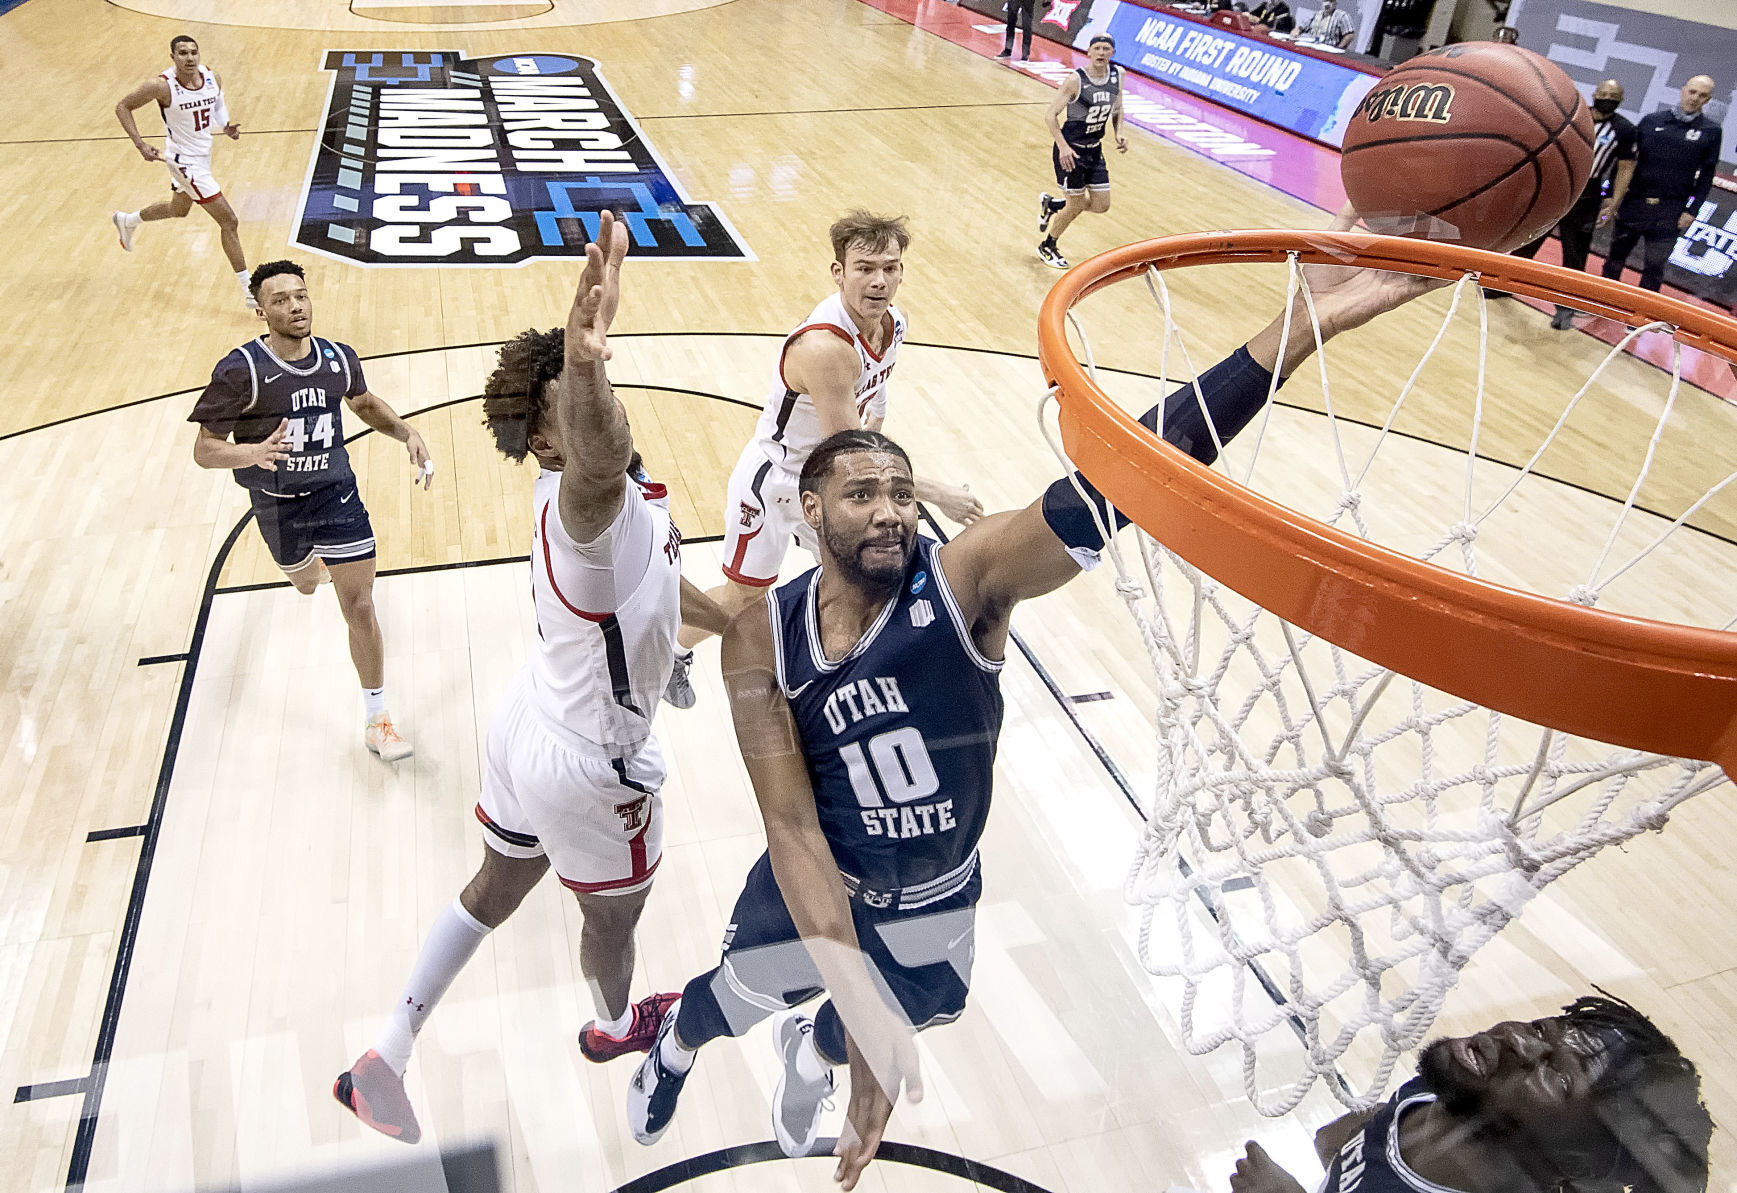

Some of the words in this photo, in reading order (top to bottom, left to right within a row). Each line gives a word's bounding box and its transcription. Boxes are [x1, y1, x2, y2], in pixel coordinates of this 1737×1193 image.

[1135, 17, 1184, 53] NCAA
[1177, 31, 1235, 68] FIRST
[1225, 46, 1302, 91] ROUND
[1141, 53, 1172, 72] HOSTED
[1168, 62, 1184, 76] BY
[1178, 64, 1213, 88] INDIANA
[1209, 77, 1261, 104] UNIVERSITY
[179, 100, 202, 110] TEXAS
[193, 108, 210, 132] 15
[488, 76, 640, 172] MARCH
[1085, 104, 1111, 124] 22
[370, 88, 522, 256] MADNESS
[291, 388, 327, 412] UTAH
[281, 412, 335, 452] 44
[286, 453, 330, 472] STATE
[823, 676, 910, 736] UTAH
[838, 726, 940, 808] 10
[860, 798, 957, 840] STATE
